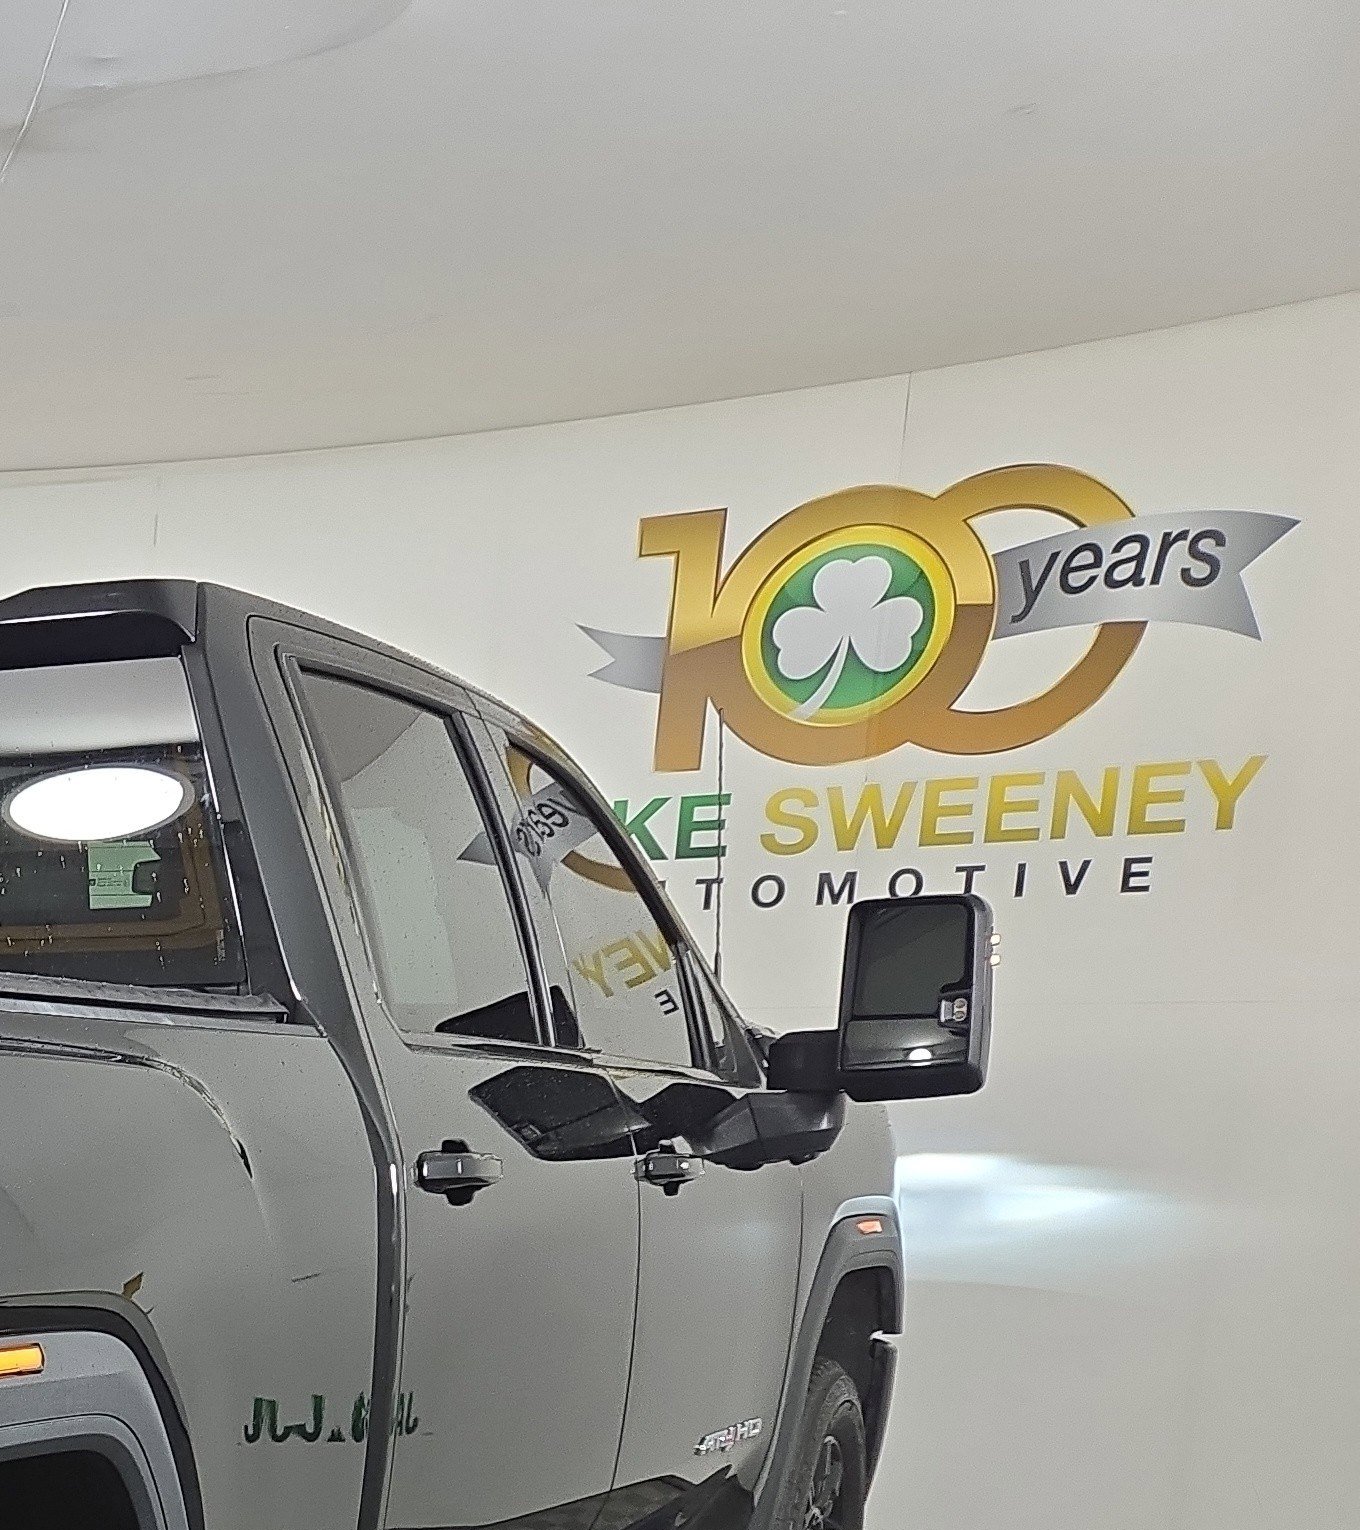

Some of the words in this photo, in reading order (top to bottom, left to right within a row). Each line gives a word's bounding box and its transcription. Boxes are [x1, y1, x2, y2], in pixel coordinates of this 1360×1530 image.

[1011, 524, 1226, 624] years
[610, 792, 733, 862] KE
[759, 754, 1269, 858] SWEENEY
[656, 854, 1156, 912] TOMOTIVE
